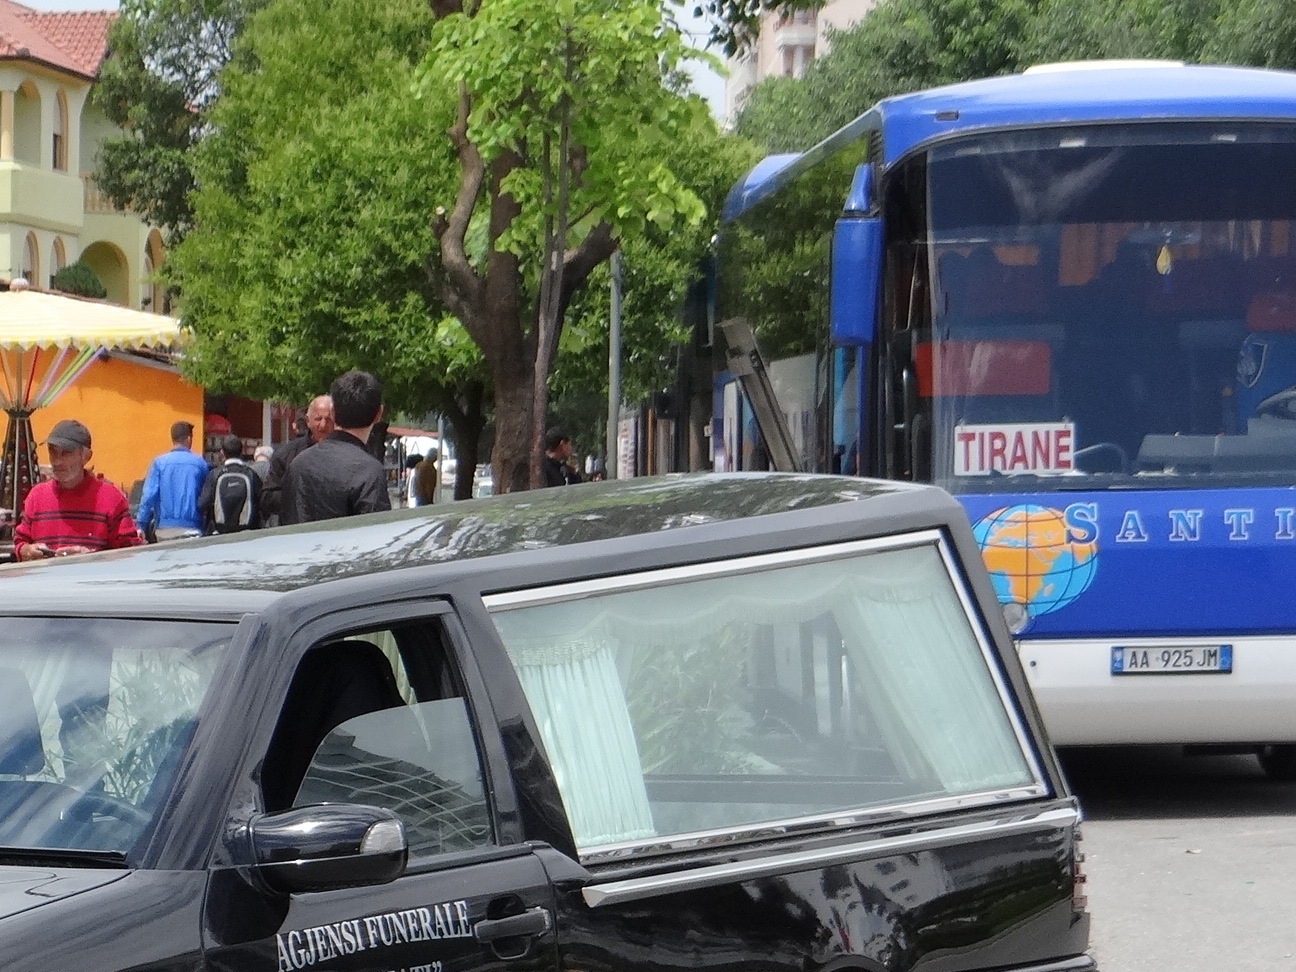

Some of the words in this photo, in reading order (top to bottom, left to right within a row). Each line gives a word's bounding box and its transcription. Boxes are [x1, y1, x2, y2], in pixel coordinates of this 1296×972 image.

[956, 429, 1072, 473] TIRANE
[1064, 502, 1296, 546] SANTI
[1128, 650, 1150, 669] AA
[1160, 649, 1194, 668] 925
[363, 900, 473, 949] FUNERALE
